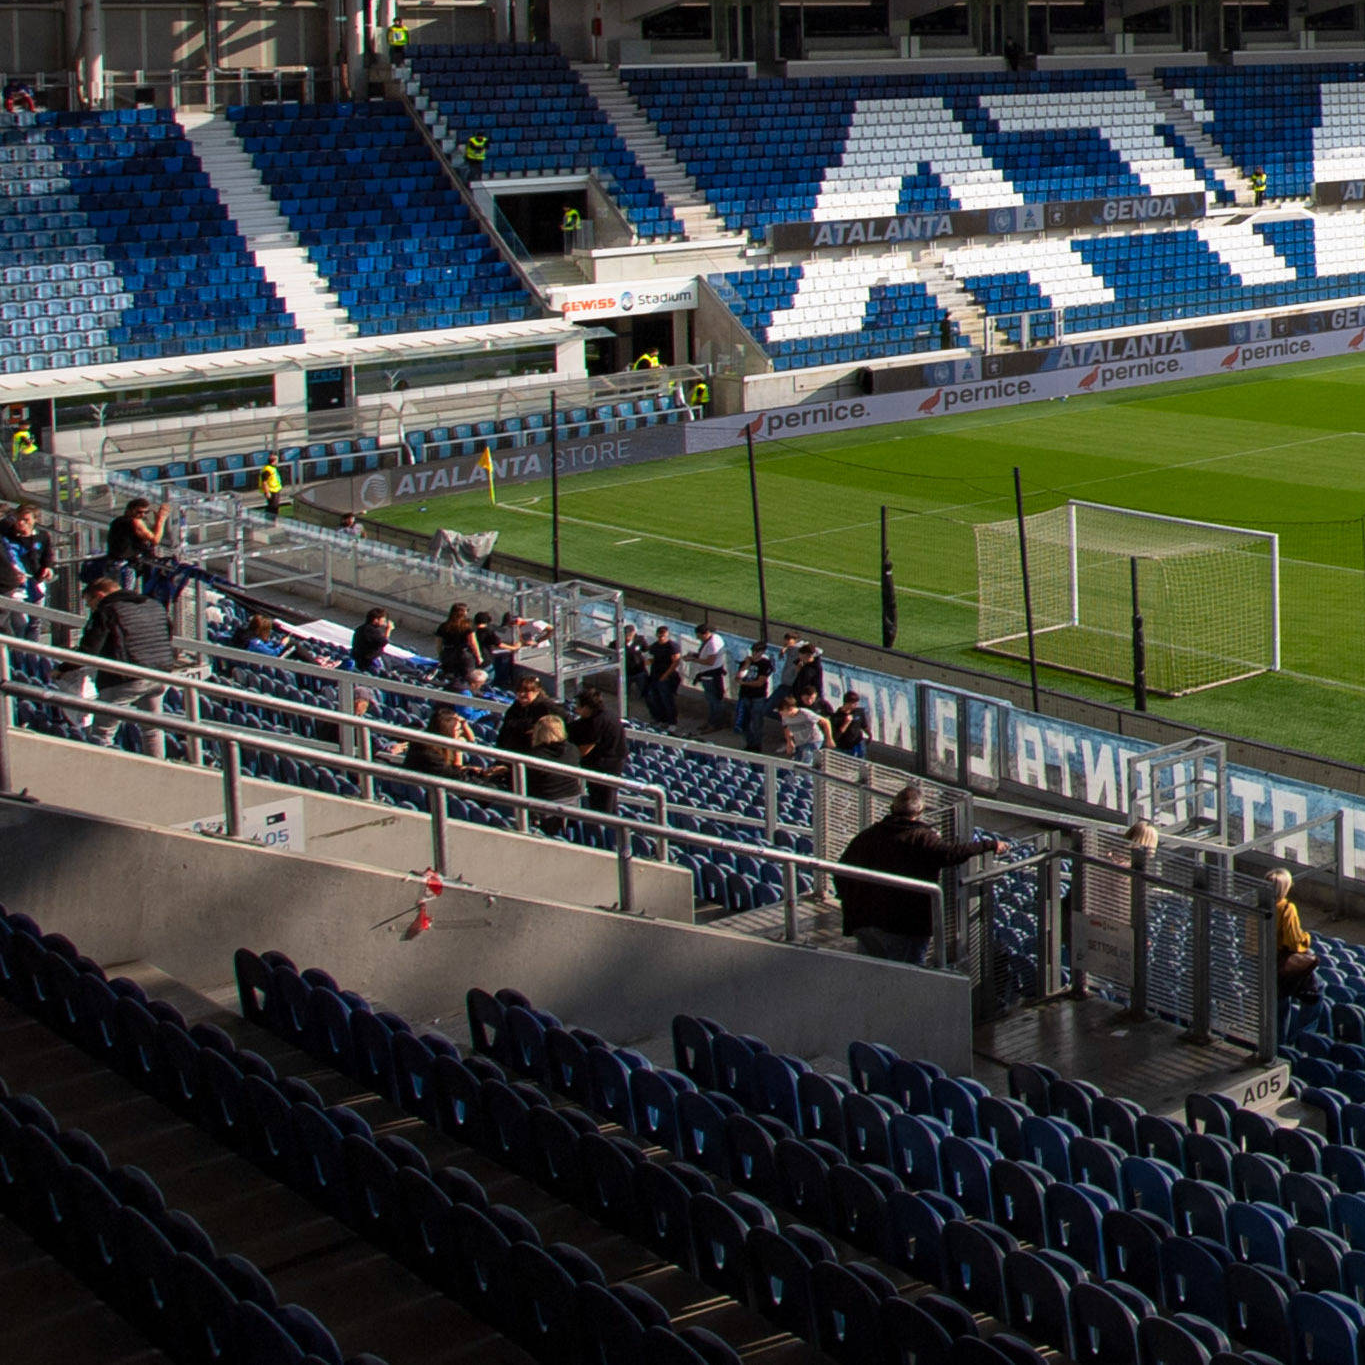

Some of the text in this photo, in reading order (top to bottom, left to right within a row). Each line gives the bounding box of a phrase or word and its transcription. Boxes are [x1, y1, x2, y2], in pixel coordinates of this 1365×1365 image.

[813, 196, 1176, 247] ATALANTA GENOA
[638, 290, 692, 306] Stadium
[1057, 330, 1187, 369] ATALANTA
[1241, 338, 1315, 365] pernice.
[1102, 357, 1184, 386] pernice.
[944, 378, 1036, 410] pernice.
[767, 401, 870, 435] pernice.
[395, 452, 543, 497] ATALANTA
[1243, 1074, 1281, 1107] A05
